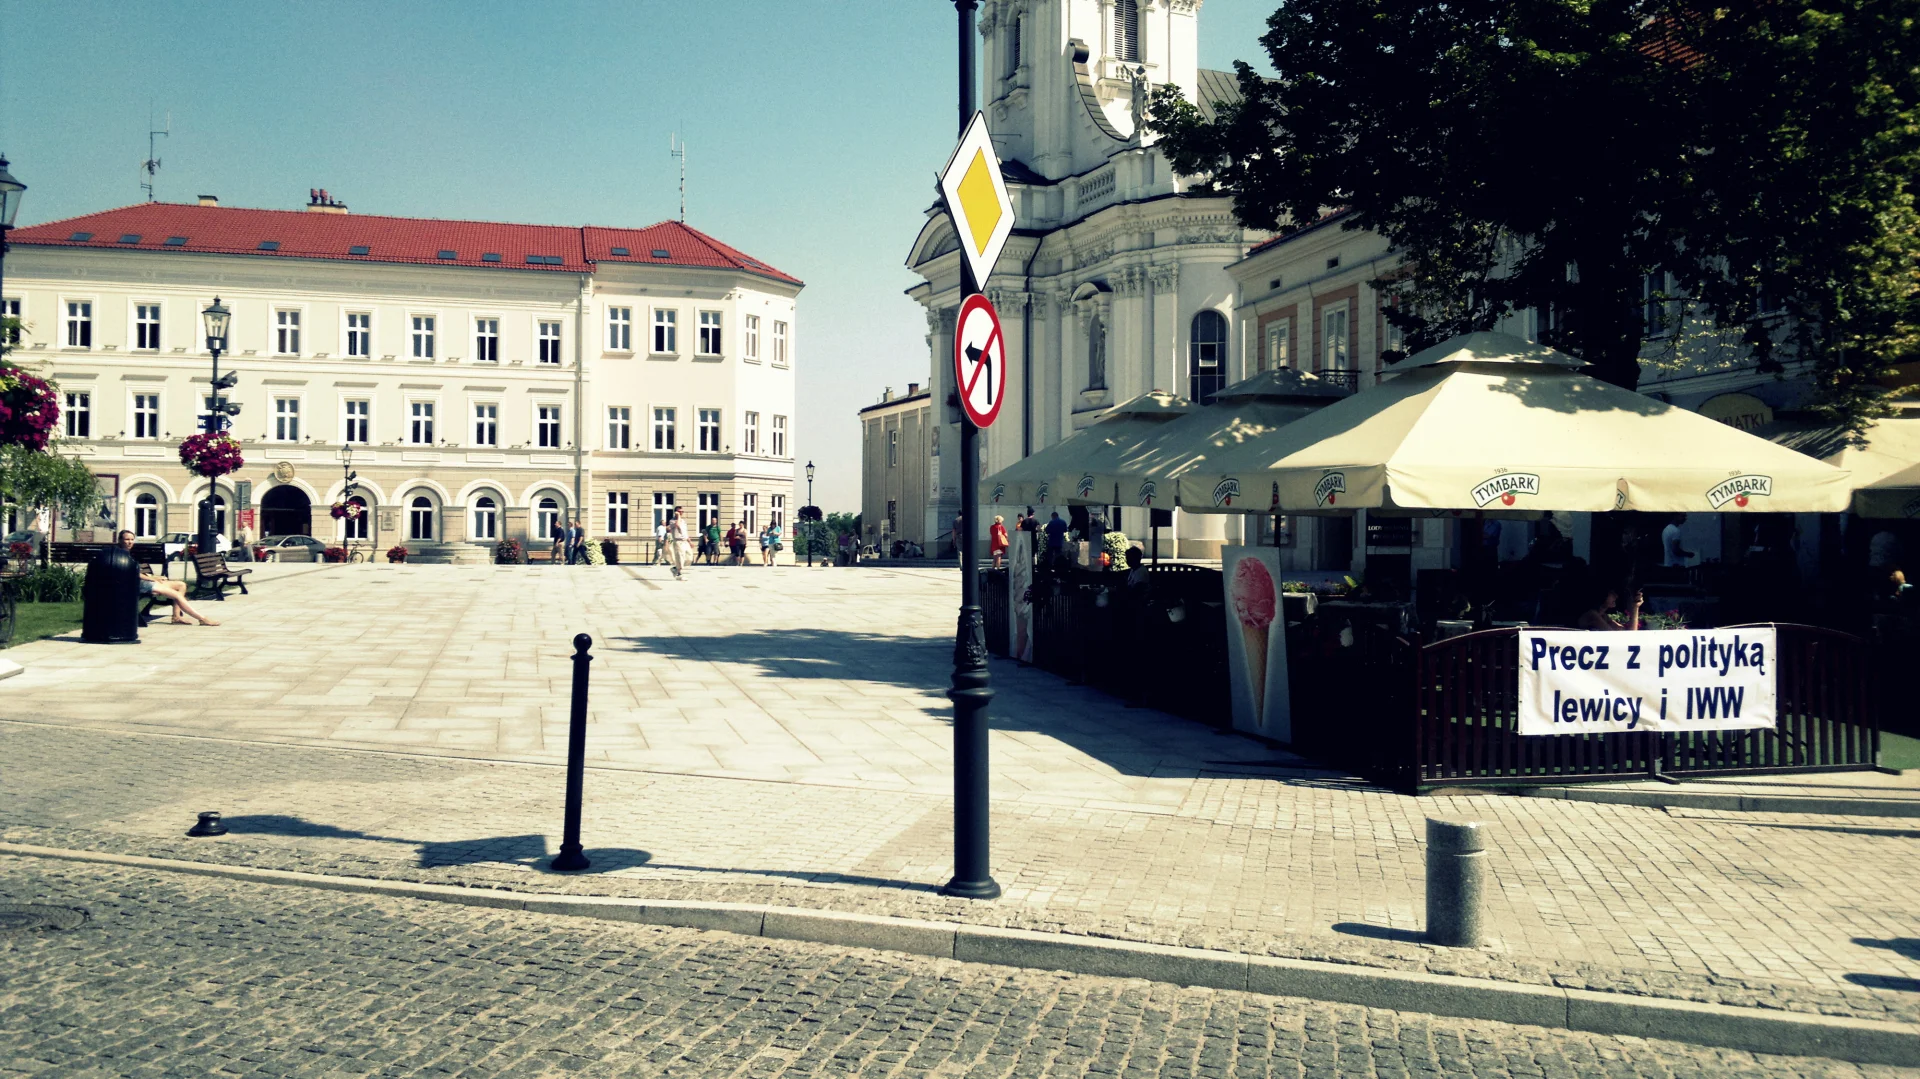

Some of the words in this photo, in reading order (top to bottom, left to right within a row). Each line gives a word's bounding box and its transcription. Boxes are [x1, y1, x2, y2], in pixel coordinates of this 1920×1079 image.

[1494, 467, 1508, 475] 1936
[1728, 469, 1742, 477] 1936
[1316, 476, 1344, 500] TYMBARK
[1475, 476, 1535, 501] TYMBARK
[1709, 478, 1768, 504] TYMBARK
[1530, 637, 1610, 671] Precz
[1626, 645, 1641, 670] z
[1658, 634, 1766, 678] polityką
[1553, 689, 1643, 730] lewicy
[1660, 688, 1668, 720] i
[1686, 686, 1745, 720] IWW
